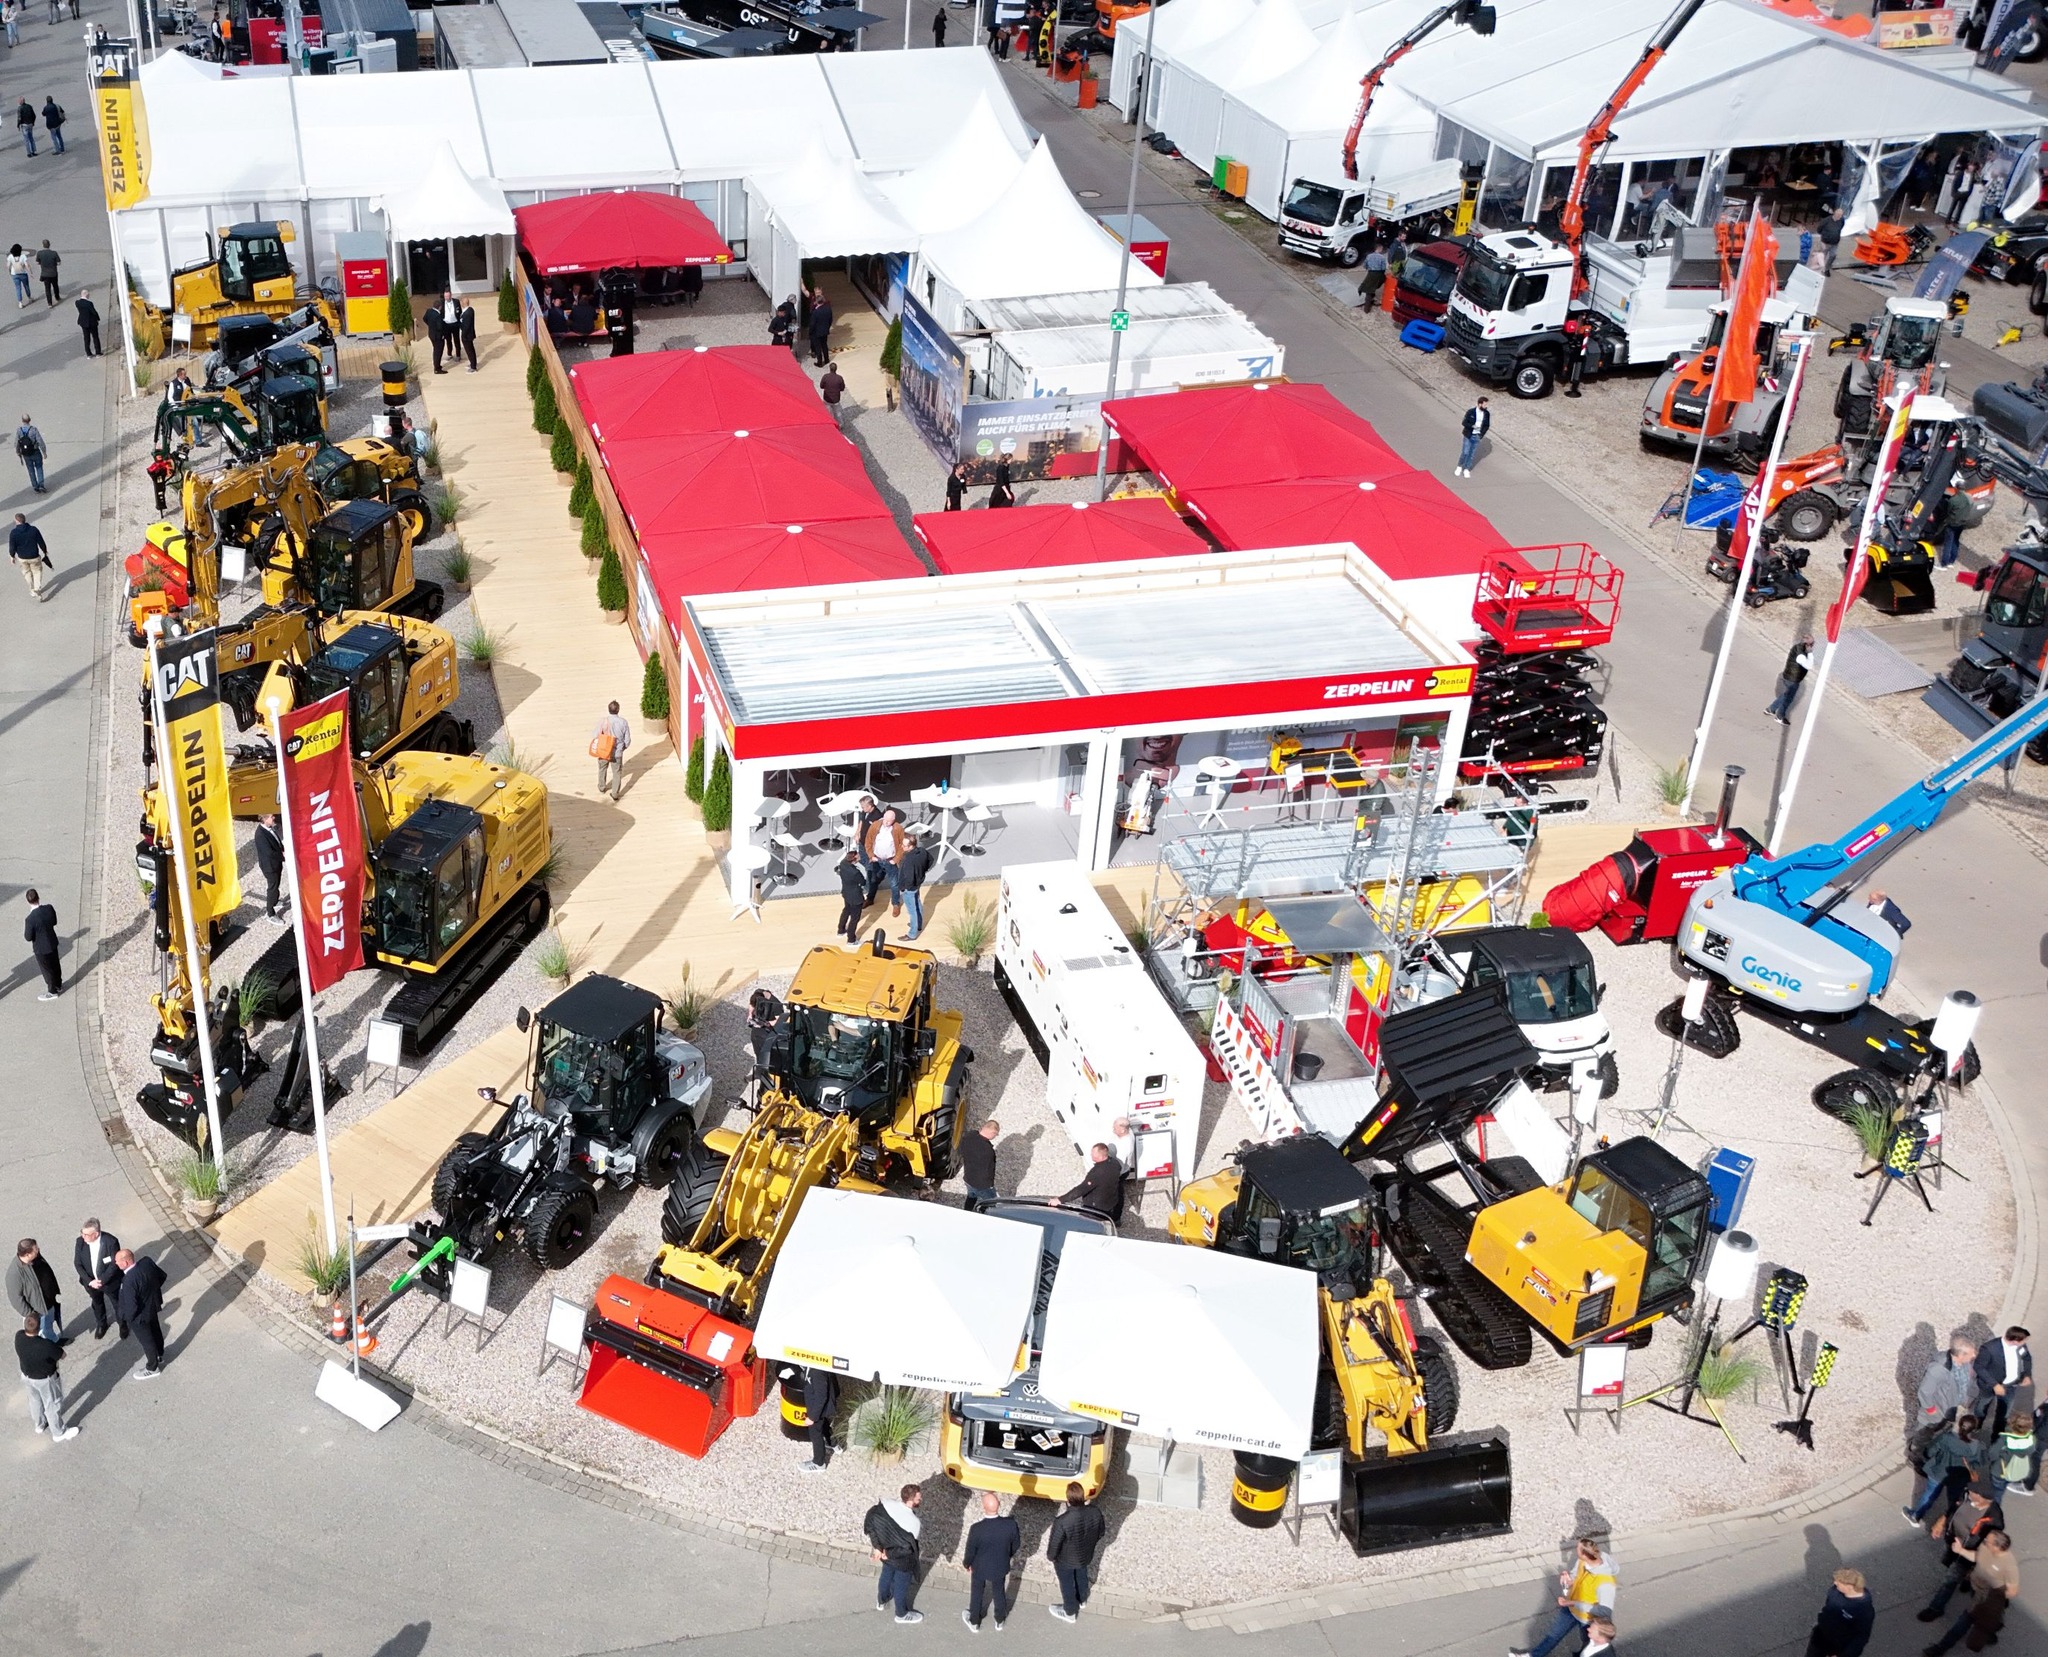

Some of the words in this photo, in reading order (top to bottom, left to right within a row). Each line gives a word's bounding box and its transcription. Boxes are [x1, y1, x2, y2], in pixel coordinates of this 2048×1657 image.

[92, 54, 126, 77] CAT
[105, 98, 126, 193] ZEPPELIN
[976, 426, 1006, 436] AUCH
[1008, 422, 1035, 433] FÜRS
[978, 416, 1015, 427] IMMER
[235, 643, 251, 662] CAT
[159, 649, 211, 702] CAT
[1323, 679, 1413, 699] ZEPPELIN
[1439, 678, 1467, 686] Rental
[287, 739, 302, 754] CAT
[304, 725, 341, 746] Rental
[183, 729, 217, 890] ZEPPELIN
[310, 790, 345, 957] ZEPPELIN
[1671, 869, 1708, 879] ZEPPELIN
[1741, 956, 1802, 993] Genie
[502, 1184, 526, 1218] CATERPILLAR
[1200, 1205, 1213, 1224] CAT
[790, 1350, 830, 1364] ZEPPELIN
[833, 1358, 848, 1369] CAT
[793, 1410, 807, 1421] CA
[1077, 1402, 1119, 1417] ZEPPELIN
[1122, 1411, 1139, 1423] CAT
[1195, 1428, 1282, 1450] zeppelin-cat.de
[1236, 1484, 1257, 1505] CAT
